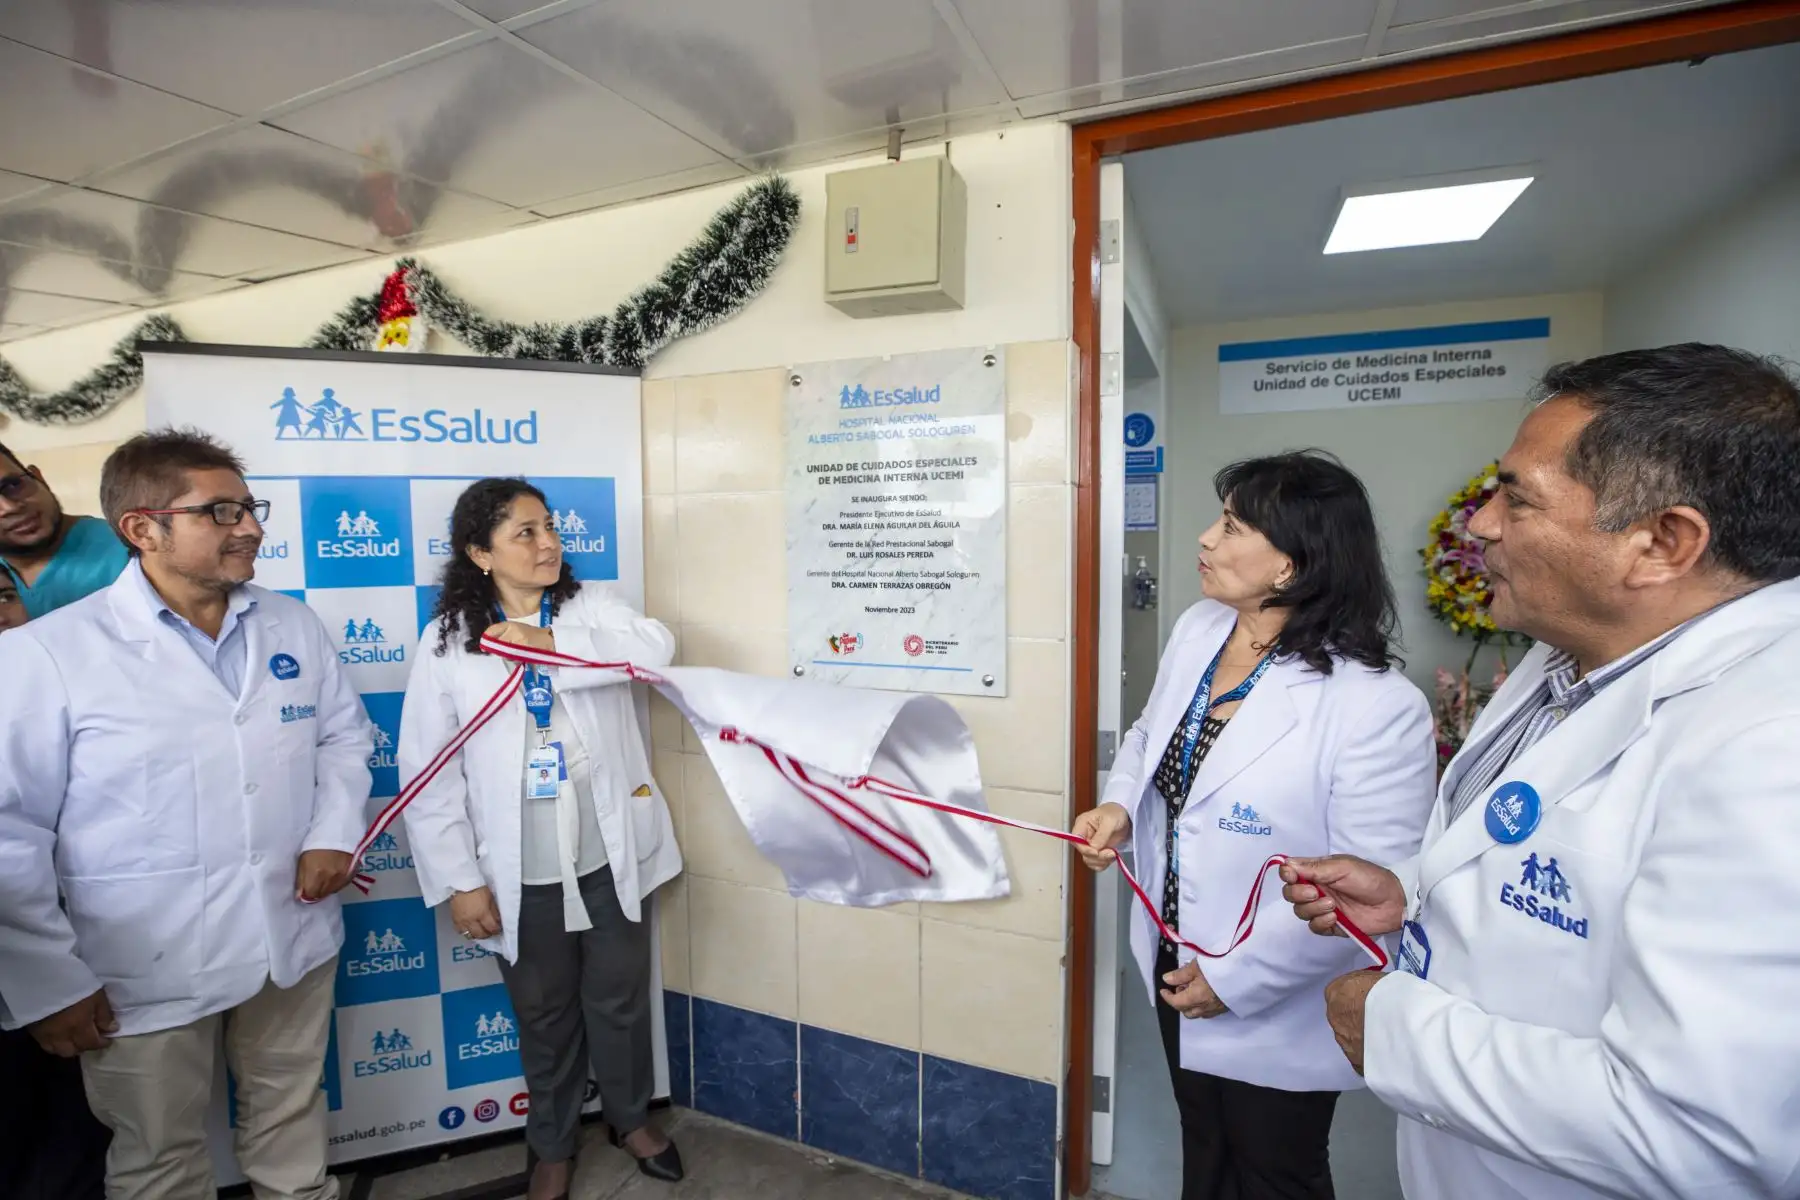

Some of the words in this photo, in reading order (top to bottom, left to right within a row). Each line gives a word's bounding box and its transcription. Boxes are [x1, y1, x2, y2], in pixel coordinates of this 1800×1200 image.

[1265, 360, 1328, 376] Servicio
[1332, 355, 1351, 370] de
[1356, 352, 1428, 368] Medicina
[1433, 349, 1492, 363] Interna
[1253, 375, 1306, 392] Unidad
[1310, 373, 1329, 388] de
[1334, 368, 1410, 387] Cuidados
[1415, 362, 1507, 383] Especiales
[873, 384, 941, 407] EsSalud
[1347, 387, 1401, 402] UCEMI
[371, 408, 538, 445] EsSalud
[839, 415, 884, 429] HOSPITAL
[889, 413, 941, 425] NACIONAL
[807, 432, 854, 444] ALBERTO
[856, 429, 906, 441] SABOGAL
[908, 424, 976, 438] SOLOGUREN
[806, 463, 844, 473] UNIDAD
[845, 462, 859, 471] DE
[861, 460, 913, 471] CUIDADOS
[915, 456, 978, 468] ESPECIALES
[818, 476, 831, 485] DE
[833, 474, 881, 485] MEDICINA
[883, 472, 929, 482] INTERNA
[931, 470, 964, 480] UCEMI
[860, 495, 898, 503] INAUGURA
[899, 494, 928, 502] SIENDO:
[874, 510, 905, 519] Ejecutivo
[905, 509, 915, 517] de
[822, 523, 838, 531] DRA.
[839, 521, 862, 530] MARÍA
[863, 522, 885, 530] ELENA
[886, 521, 917, 530] AGUILAR
[918, 521, 932, 529] DEL
[933, 520, 961, 529] ÁGUILA
[317, 538, 400, 558] EsSalud
[561, 534, 606, 553] alud
[828, 540, 854, 548] Gerente
[855, 540, 864, 548] de
[864, 540, 871, 548] la
[871, 540, 885, 548] Red
[886, 539, 926, 548] Prestacional
[927, 539, 954, 549] Sabogal
[846, 551, 858, 559] DR.
[859, 551, 874, 559] LUIS
[875, 551, 906, 559] ROSALES
[906, 551, 934, 559] PEREDA
[841, 570, 867, 579] Hospital
[867, 570, 894, 578] Nacional
[895, 570, 919, 578] Alberto
[919, 570, 945, 580] Sabogal
[946, 570, 980, 580] Sologuren
[831, 581, 848, 589] DRA.
[848, 581, 878, 589] CARMEN
[879, 582, 914, 590] TERRAZAS
[915, 580, 951, 590] OBREGÓN
[864, 605, 899, 614] Noviembre
[899, 606, 916, 614] 2023
[338, 644, 405, 664] sSalud
[1218, 817, 1272, 836] EsSalud
[1490, 797, 1521, 837] EsSalud
[362, 852, 416, 873] Salu
[1500, 882, 1589, 939] EsSalud
[346, 951, 426, 977] EsSalud
[458, 1035, 520, 1060] EsSalu
[353, 1050, 432, 1078] EsSalud
